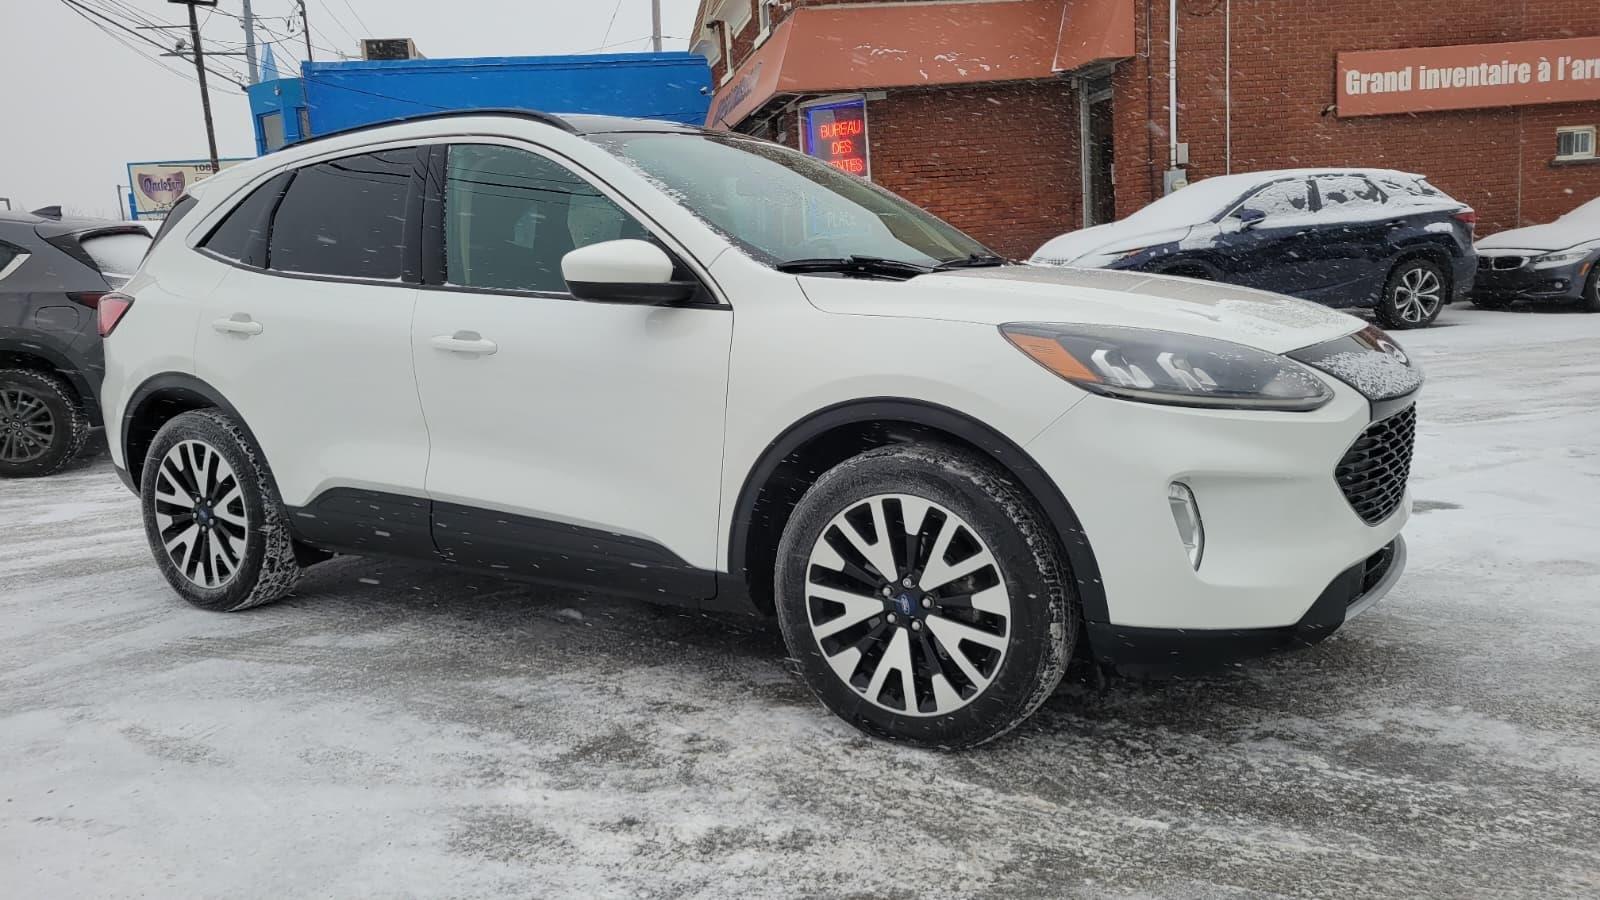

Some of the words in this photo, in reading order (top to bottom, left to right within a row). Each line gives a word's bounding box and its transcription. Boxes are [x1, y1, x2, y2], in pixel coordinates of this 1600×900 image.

[1346, 66, 1412, 95] Grand
[1420, 60, 1531, 90] inventaire
[1537, 56, 1551, 82] à
[820, 119, 862, 138] BUREAU
[831, 140, 852, 155] DES
[830, 158, 863, 172] NTES
